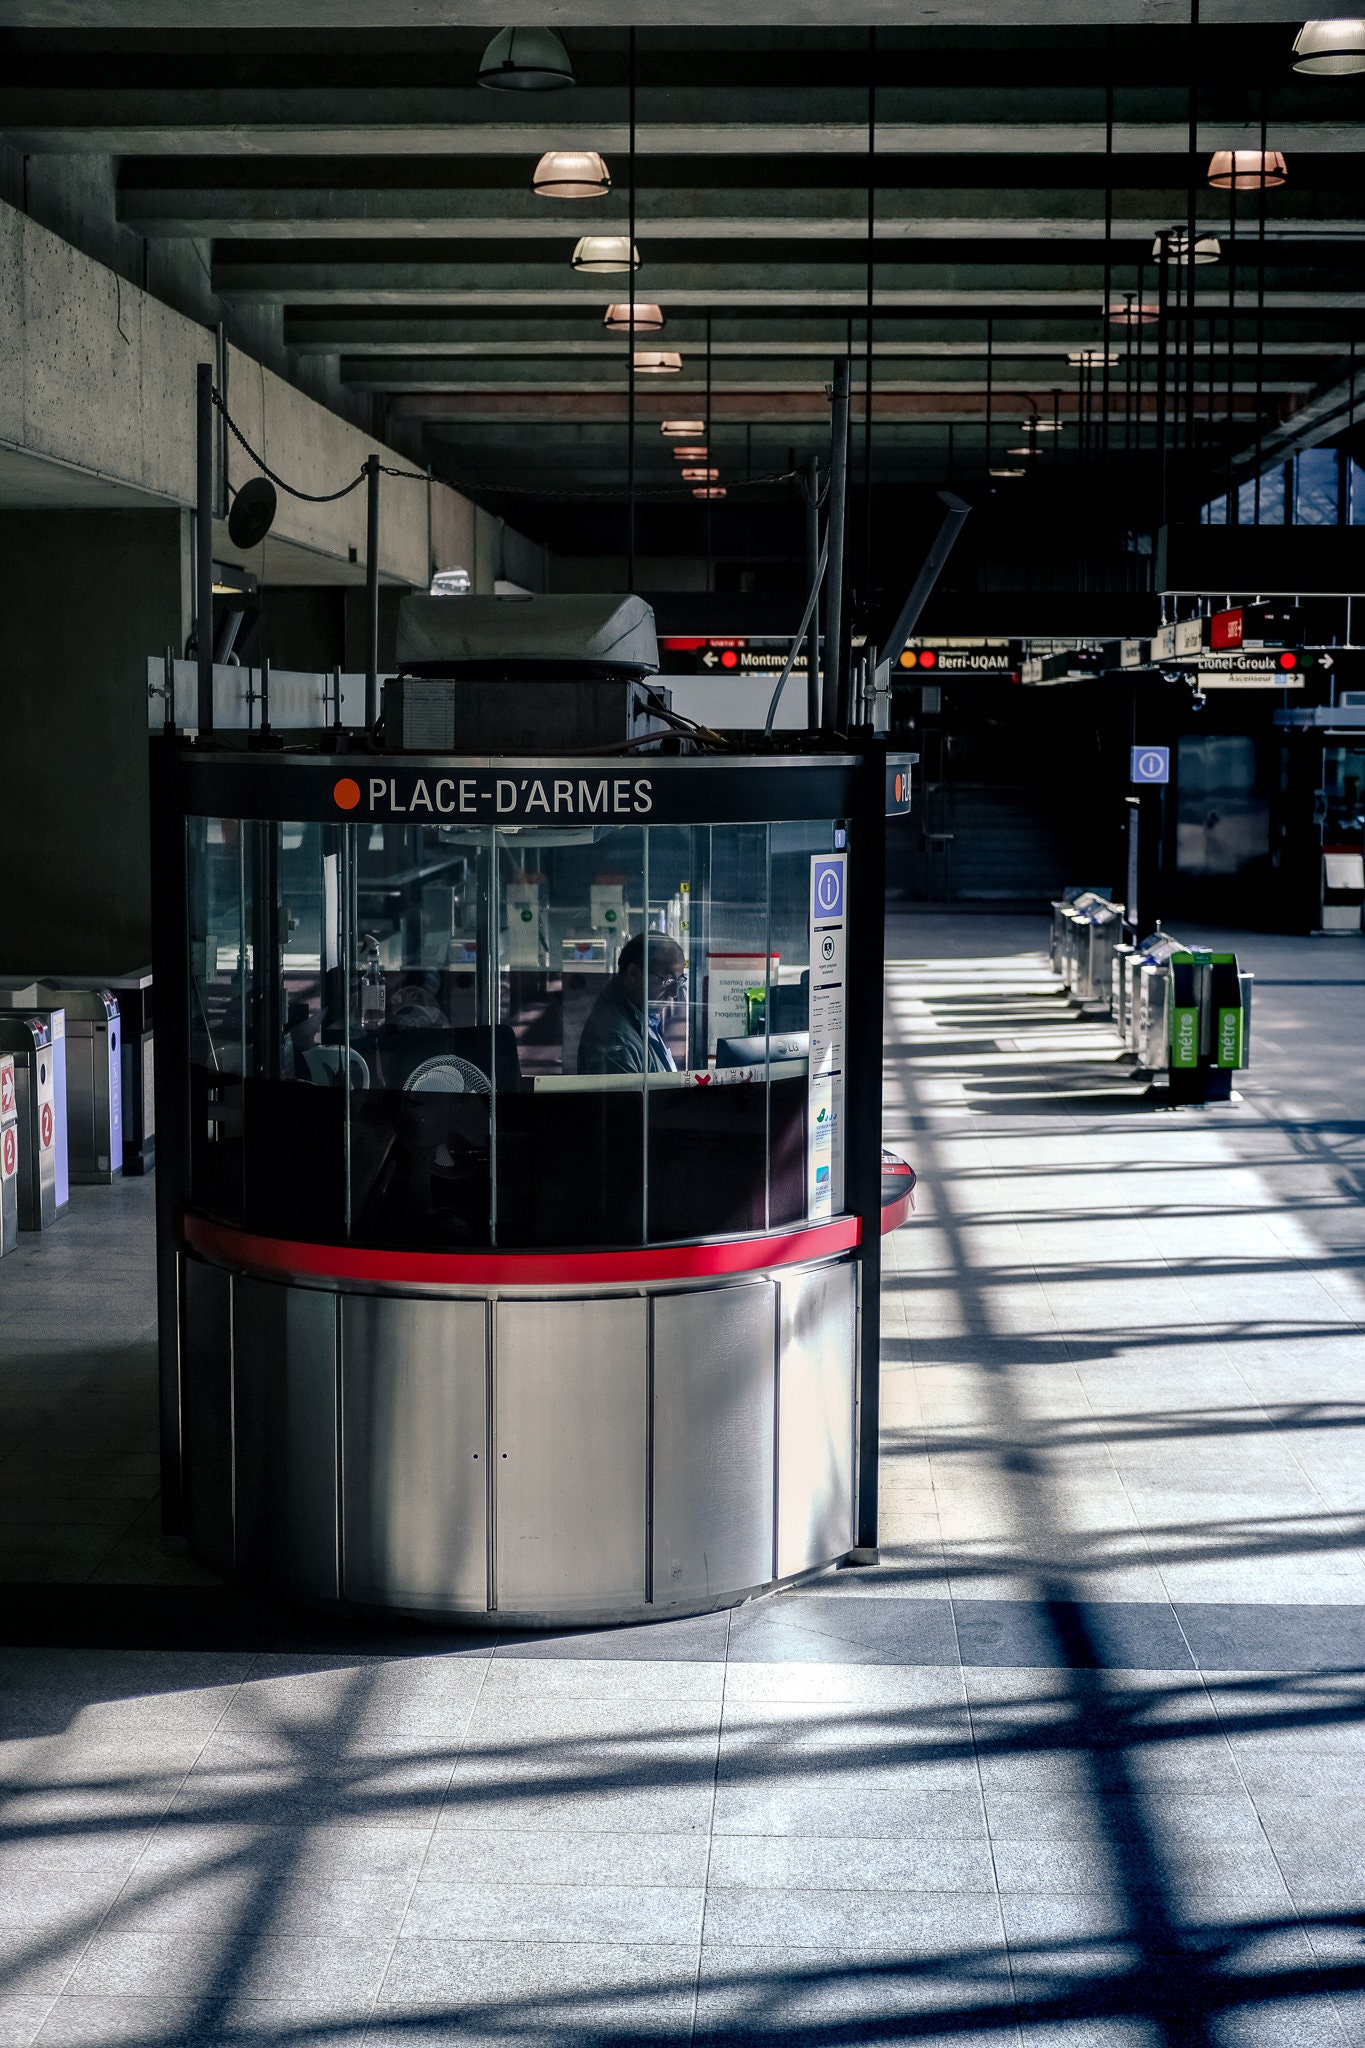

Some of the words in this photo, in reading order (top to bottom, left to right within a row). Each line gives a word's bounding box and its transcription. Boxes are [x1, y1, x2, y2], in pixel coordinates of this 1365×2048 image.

[938, 655, 1009, 670] Berri-UQAM
[368, 778, 654, 814] PLACE-D'ARMES
[788, 1041, 800, 1052] LG
[1178, 1013, 1193, 1061] métro
[1221, 1013, 1236, 1061] métro
[43, 1111, 50, 1136] 2
[6, 1142, 14, 1165] 2
